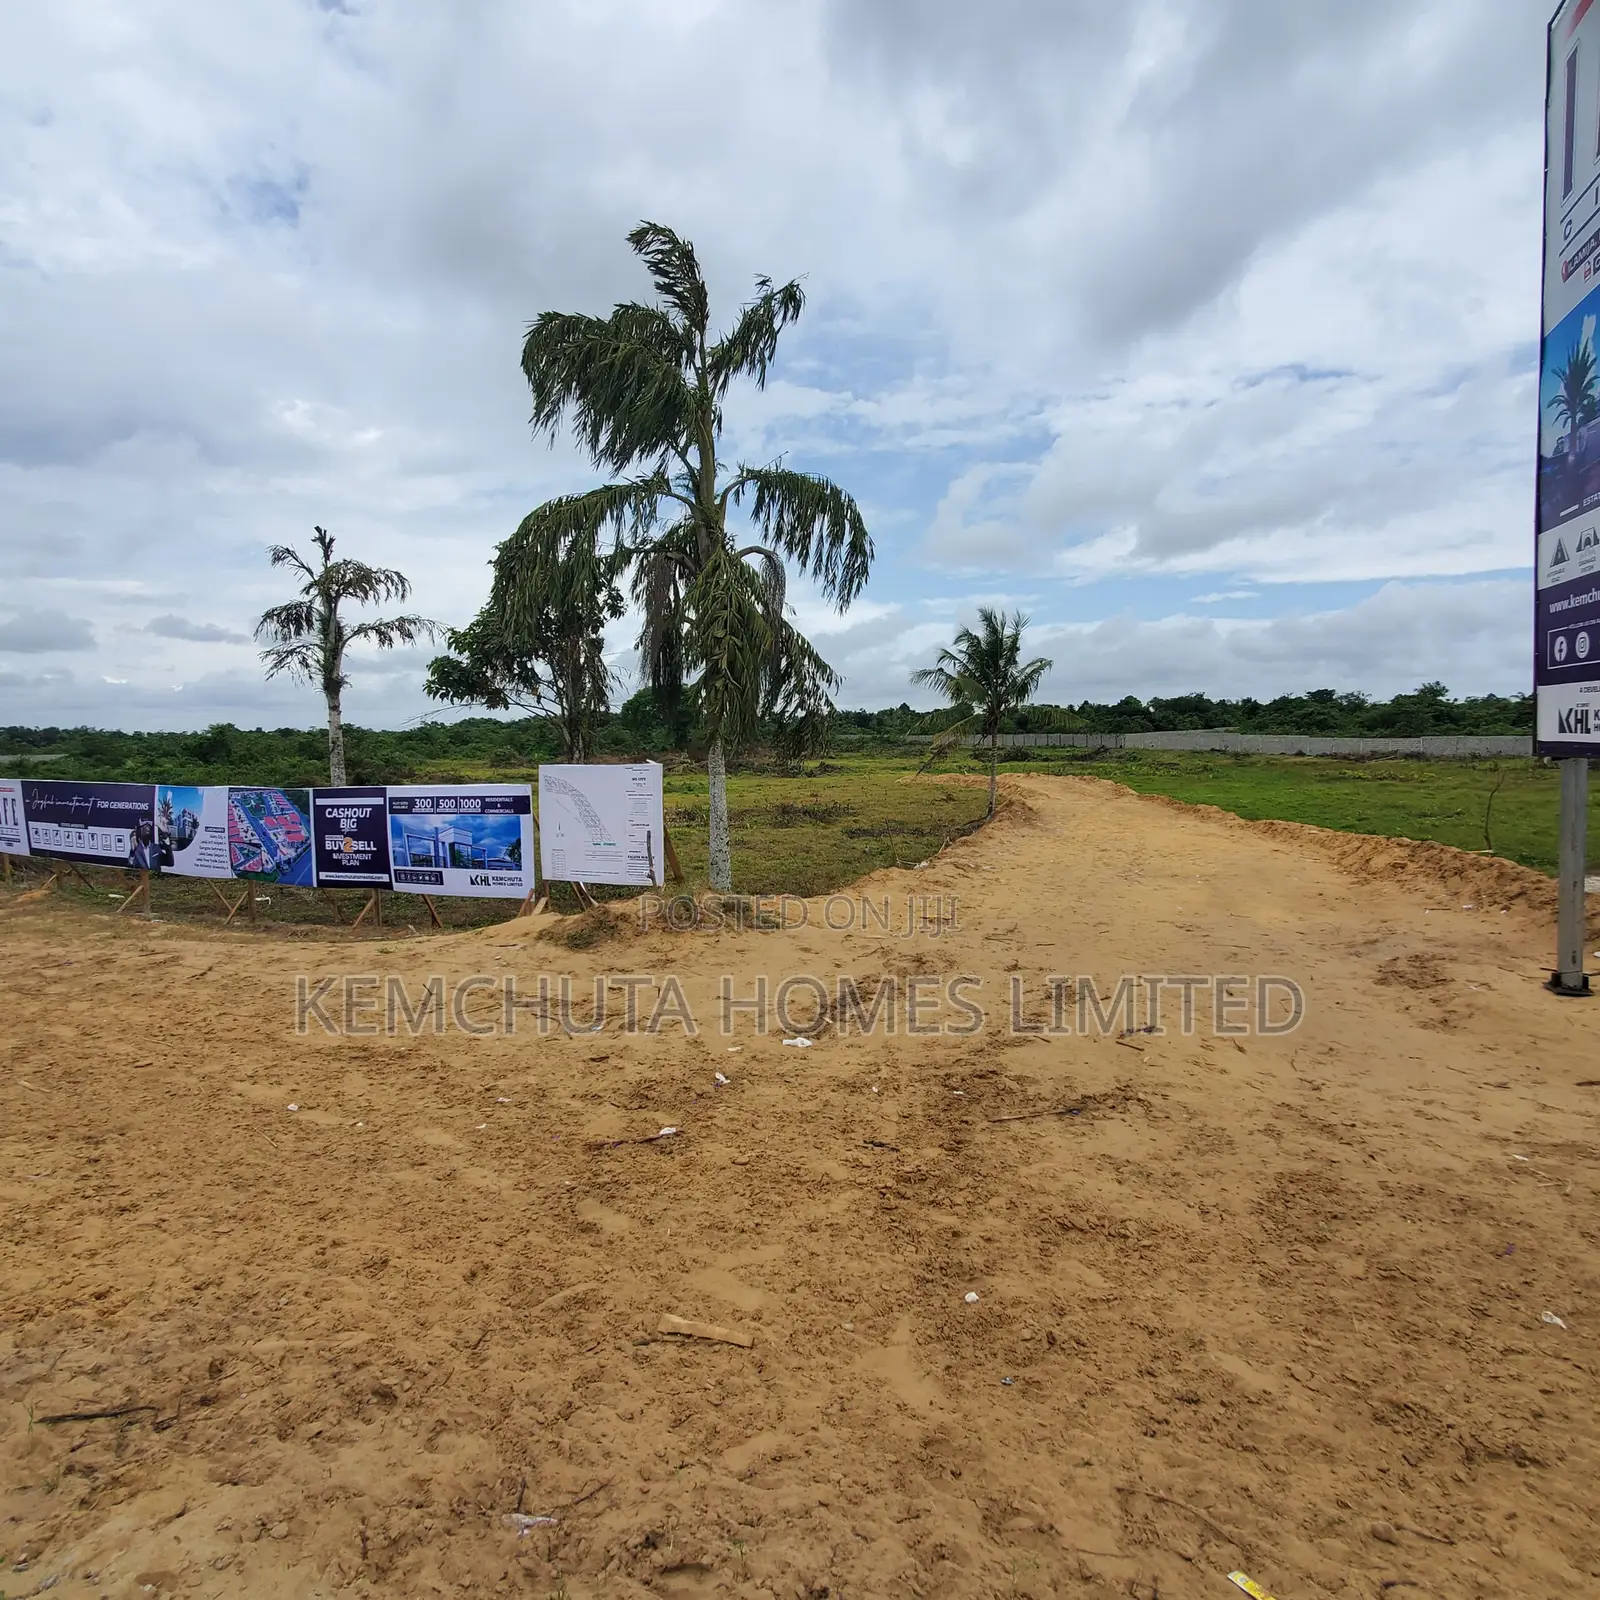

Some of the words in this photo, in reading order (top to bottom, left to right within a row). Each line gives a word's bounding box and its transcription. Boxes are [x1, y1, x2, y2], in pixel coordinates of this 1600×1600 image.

[1558, 707, 1591, 734] KHL
[96, 801, 109, 809] FOR
[109, 801, 149, 811] GENERATIONS
[414, 798, 432, 808] 300
[438, 799, 456, 808] 500
[459, 798, 481, 808] 1000
[325, 807, 372, 818] CASHOUT
[340, 818, 358, 829] BIG
[332, 852, 372, 860] INVESTMENT
[341, 859, 360, 867] PLAN
[469, 874, 491, 887] KHL
[491, 875, 523, 883] KEMCHUTA
